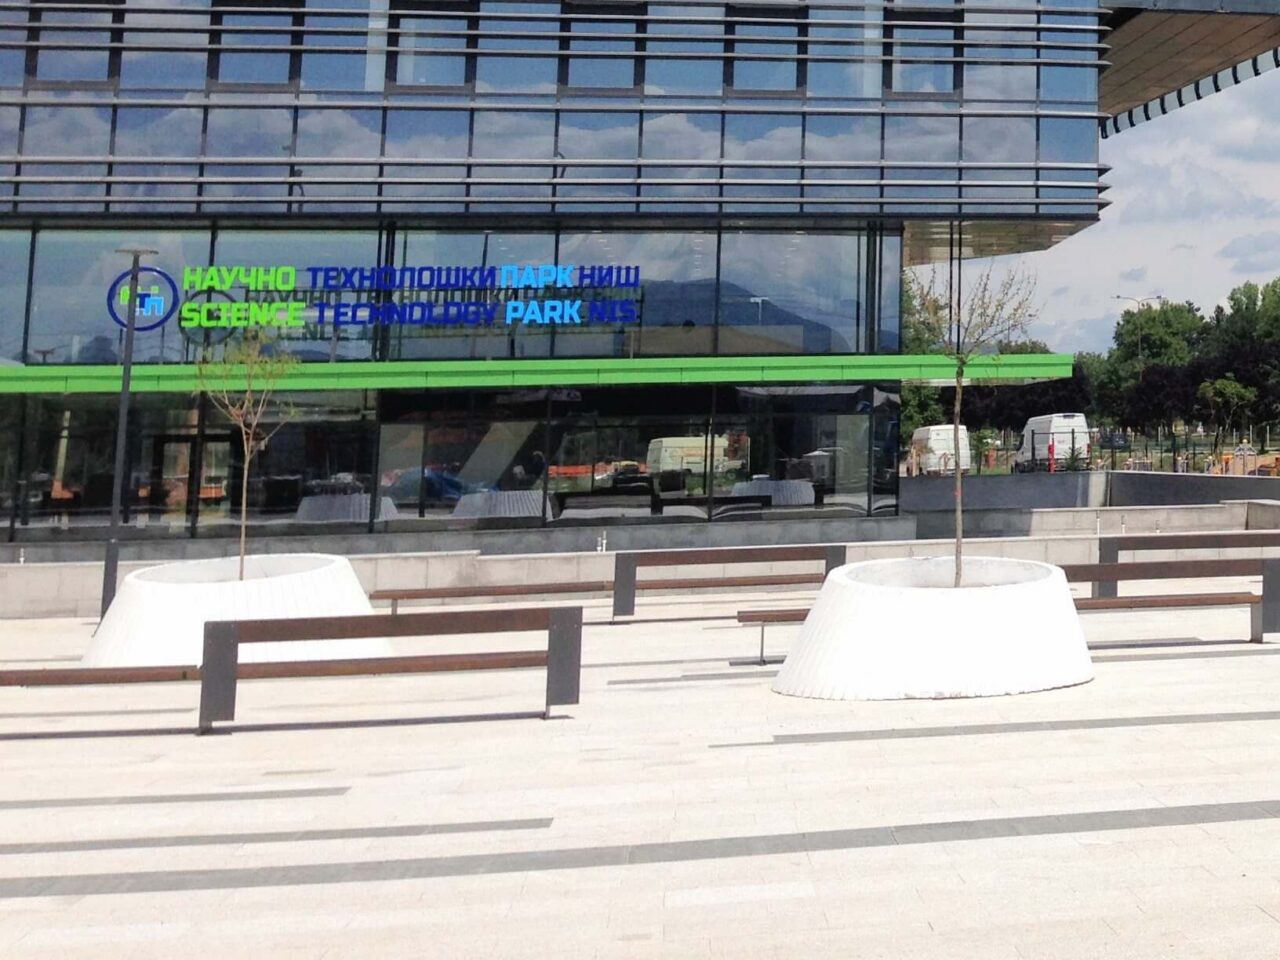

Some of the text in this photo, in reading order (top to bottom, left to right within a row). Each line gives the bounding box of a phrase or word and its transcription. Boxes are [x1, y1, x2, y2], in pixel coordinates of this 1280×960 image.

[183, 264, 640, 291] НАУЧНО ТЕХНОЛОШКИ ПАРК НИШ
[181, 301, 305, 327] SCIENCE
[314, 301, 498, 325] TECHNOLOGY
[506, 300, 582, 324] PARK
